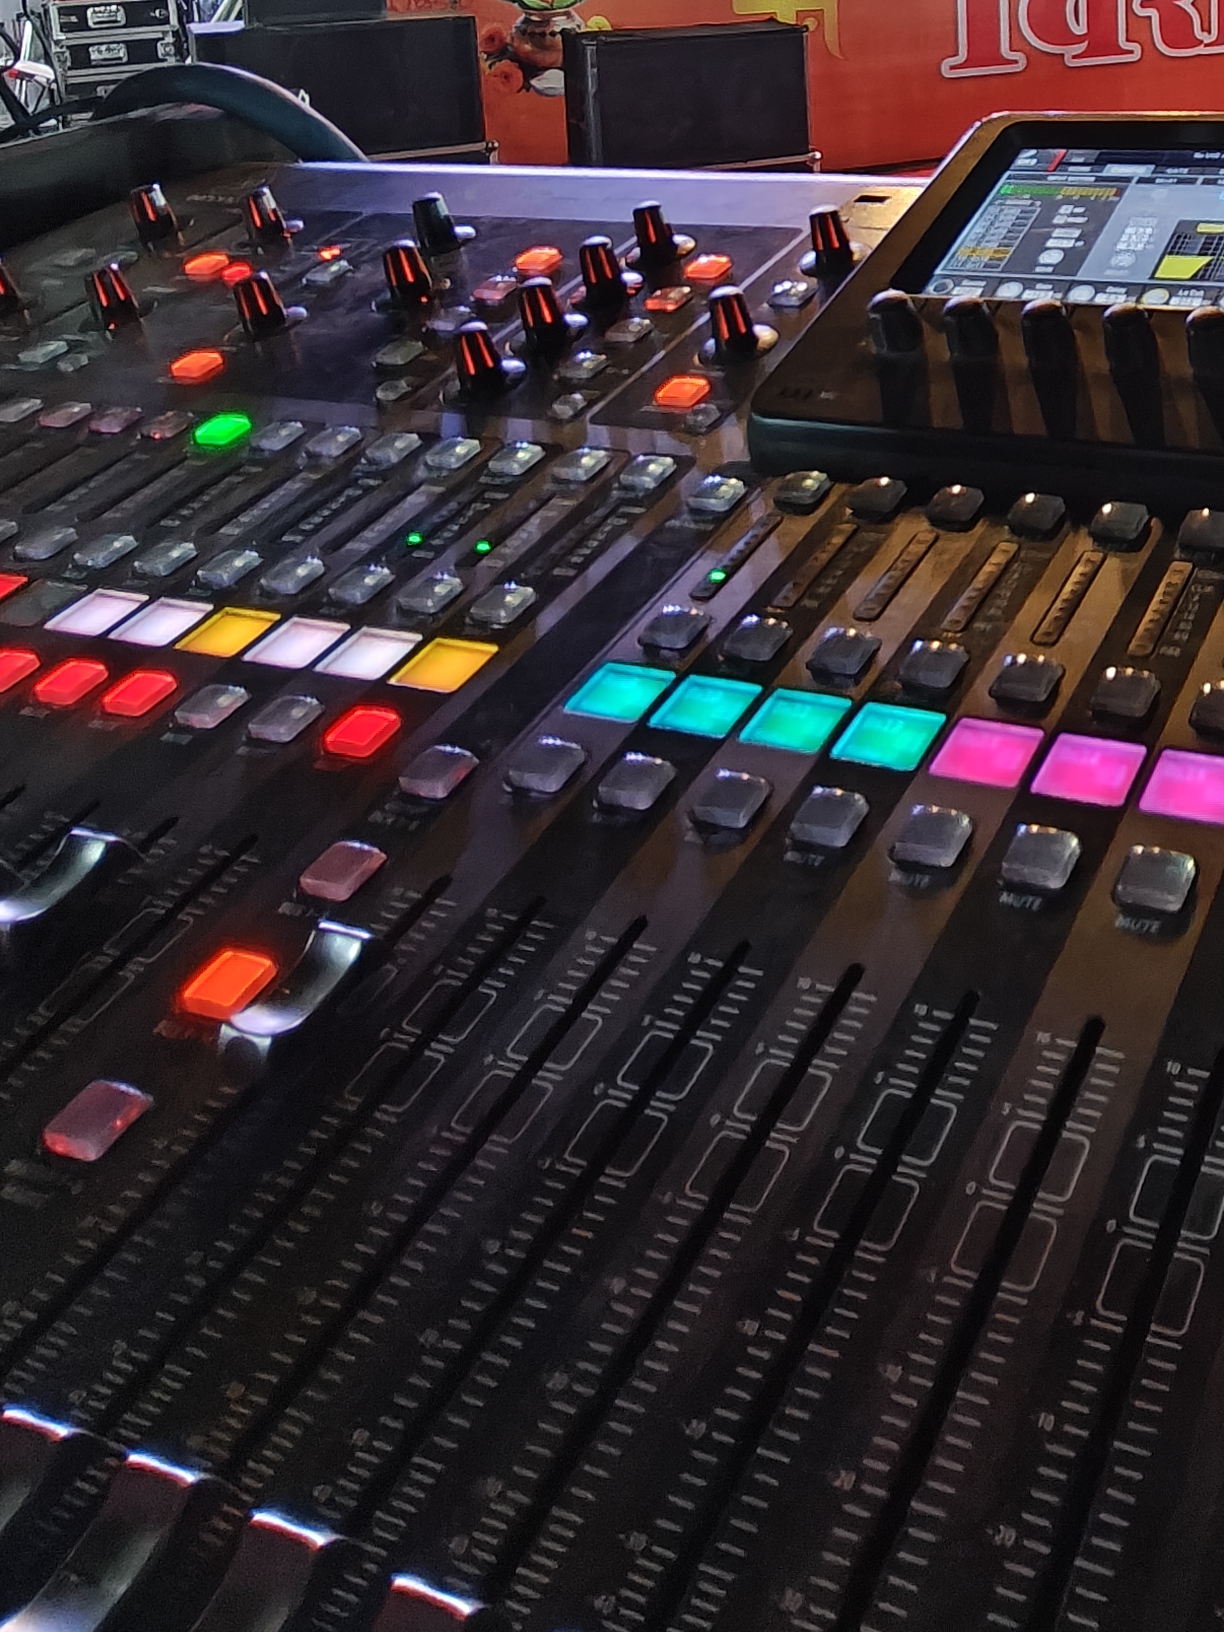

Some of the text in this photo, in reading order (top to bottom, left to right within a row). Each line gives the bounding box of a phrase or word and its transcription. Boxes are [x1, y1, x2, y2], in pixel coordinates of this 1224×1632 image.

[1000, 890, 1043, 912] MUTE
[1114, 912, 1162, 936] MUTE
[1166, 1059, 1182, 1076] 10
